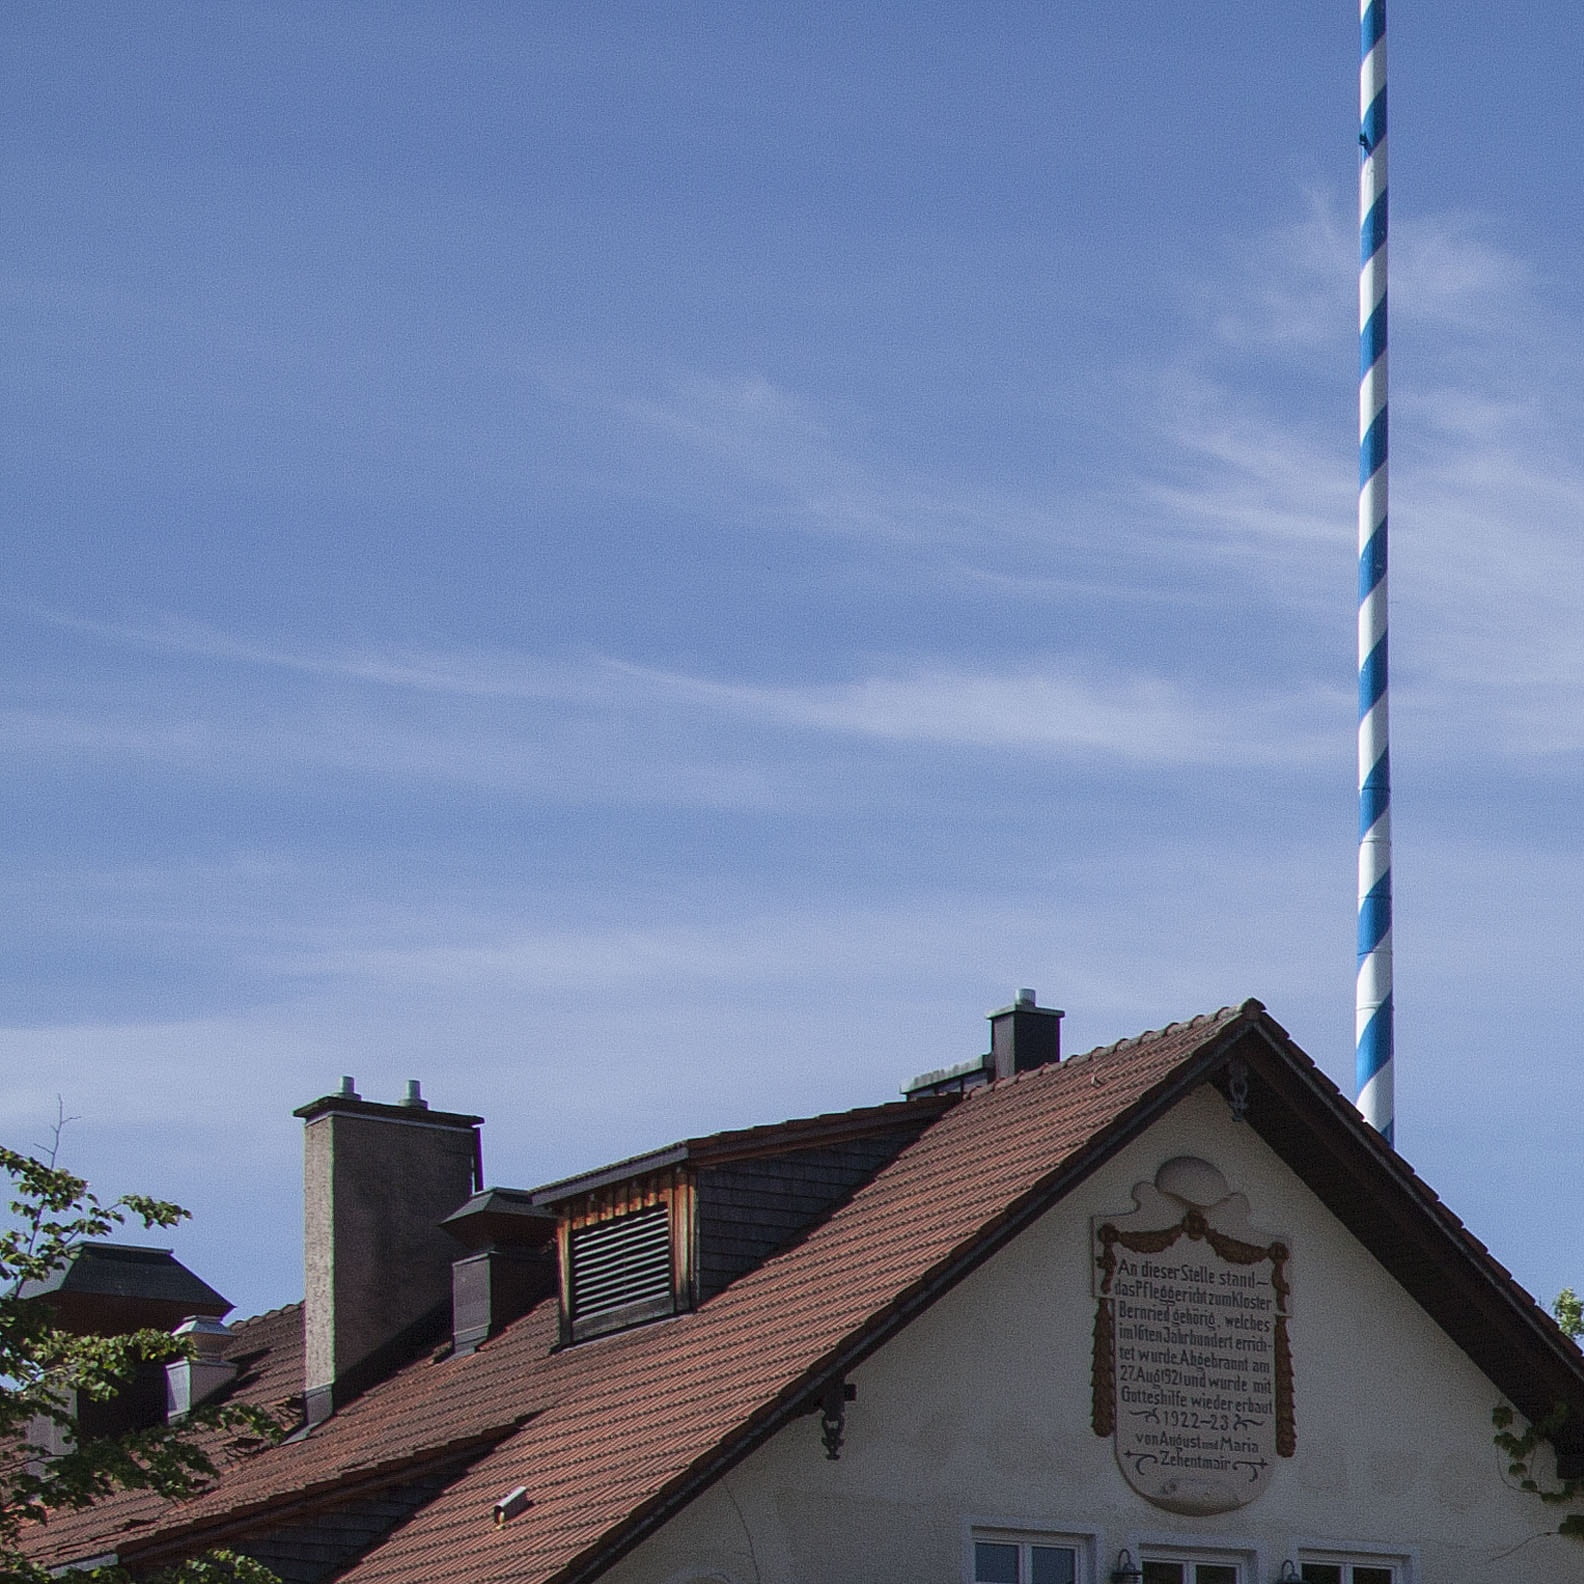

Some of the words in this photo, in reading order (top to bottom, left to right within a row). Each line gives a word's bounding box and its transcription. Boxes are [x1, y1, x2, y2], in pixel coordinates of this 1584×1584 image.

[1117, 1258, 1137, 1277] An
[1141, 1261, 1180, 1281] dieser
[1180, 1264, 1215, 1285] Stelle
[1114, 1278, 1135, 1298] das
[1208, 1291, 1232, 1307] zum
[1232, 1290, 1273, 1311] Kloster
[1119, 1300, 1170, 1322] Bernried
[1224, 1313, 1271, 1333] welches
[1119, 1322, 1133, 1340] im
[1162, 1326, 1233, 1350] Jahrhundert
[1119, 1346, 1135, 1361] tet
[1180, 1349, 1249, 1372] Abgebrannt
[1252, 1360, 1270, 1373] am
[1183, 1371, 1206, 1388] und
[1209, 1375, 1248, 1392] wurde
[1252, 1376, 1272, 1394] mit
[1120, 1385, 1188, 1409] Gotteshilfe
[1190, 1392, 1233, 1411] wieder
[1235, 1396, 1273, 1415] erbaut
[1135, 1433, 1159, 1446] von
[1159, 1430, 1202, 1452] August
[1219, 1436, 1259, 1453] Maria
[1159, 1449, 1231, 1471] Zehentmair
